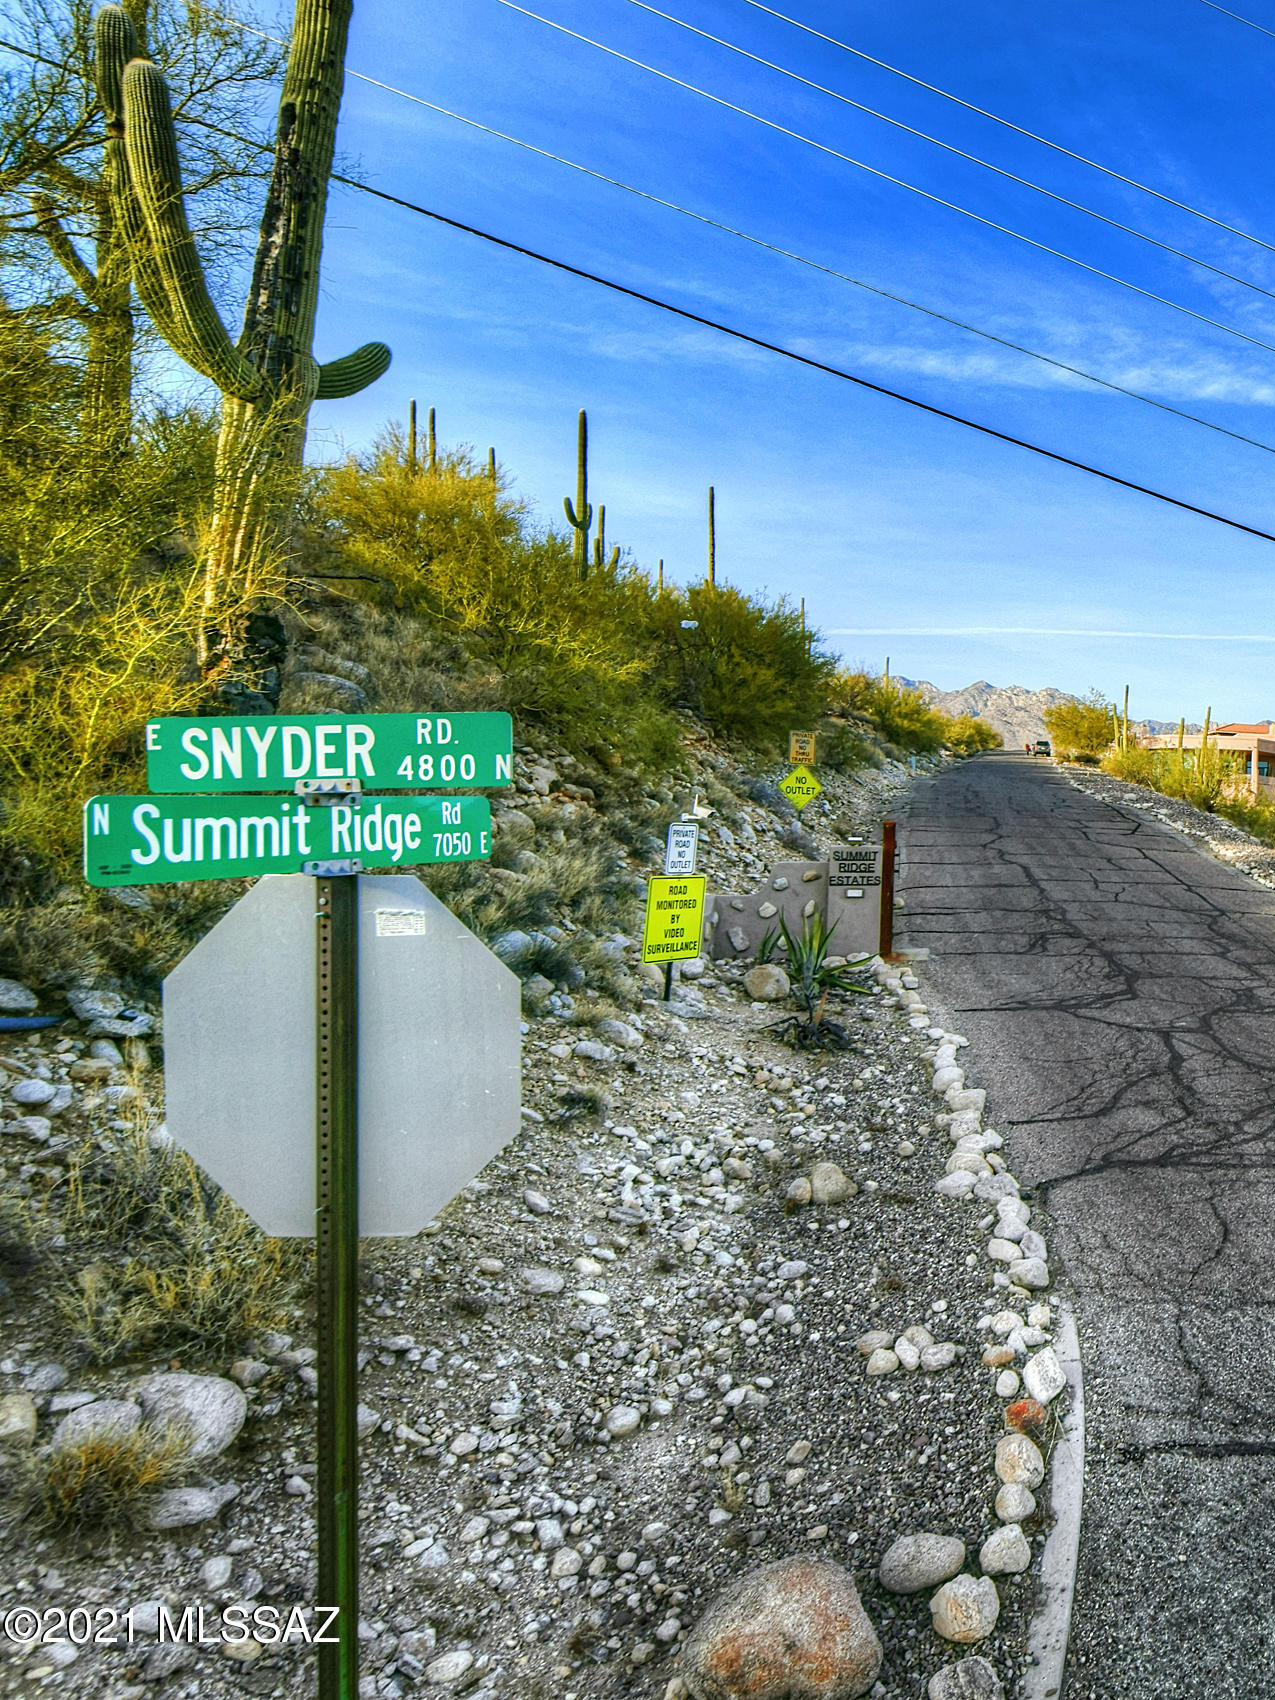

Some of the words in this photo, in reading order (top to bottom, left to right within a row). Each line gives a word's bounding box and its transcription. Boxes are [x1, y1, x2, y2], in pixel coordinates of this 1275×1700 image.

[146, 724, 161, 750] E
[180, 724, 375, 780] SNYDER
[417, 718, 460, 745] RD.
[397, 754, 476, 781] 4800
[495, 754, 512, 780] N
[796, 776, 807, 784] NO
[785, 786, 816, 795] OUTLET
[93, 803, 110, 836] N
[131, 803, 311, 865] Summit
[331, 804, 421, 863] Ridge
[442, 802, 461, 825] Rd
[673, 829, 695, 839] PRIVATE
[433, 831, 472, 857] 7050
[480, 831, 489, 854] E
[675, 840, 690, 848] ROAD
[678, 850, 686, 859] NO
[833, 851, 878, 861] SUMMIT
[670, 860, 691, 869] OUTLET
[839, 863, 875, 873] RIDGE
[829, 876, 881, 886] ESTATES
[669, 885, 687, 895] ROAD
[656, 899, 697, 910] MONITORED
[671, 914, 680, 924] BY
[664, 928, 684, 938] VIDEO
[647, 941, 697, 955] SURVEILLANCE
